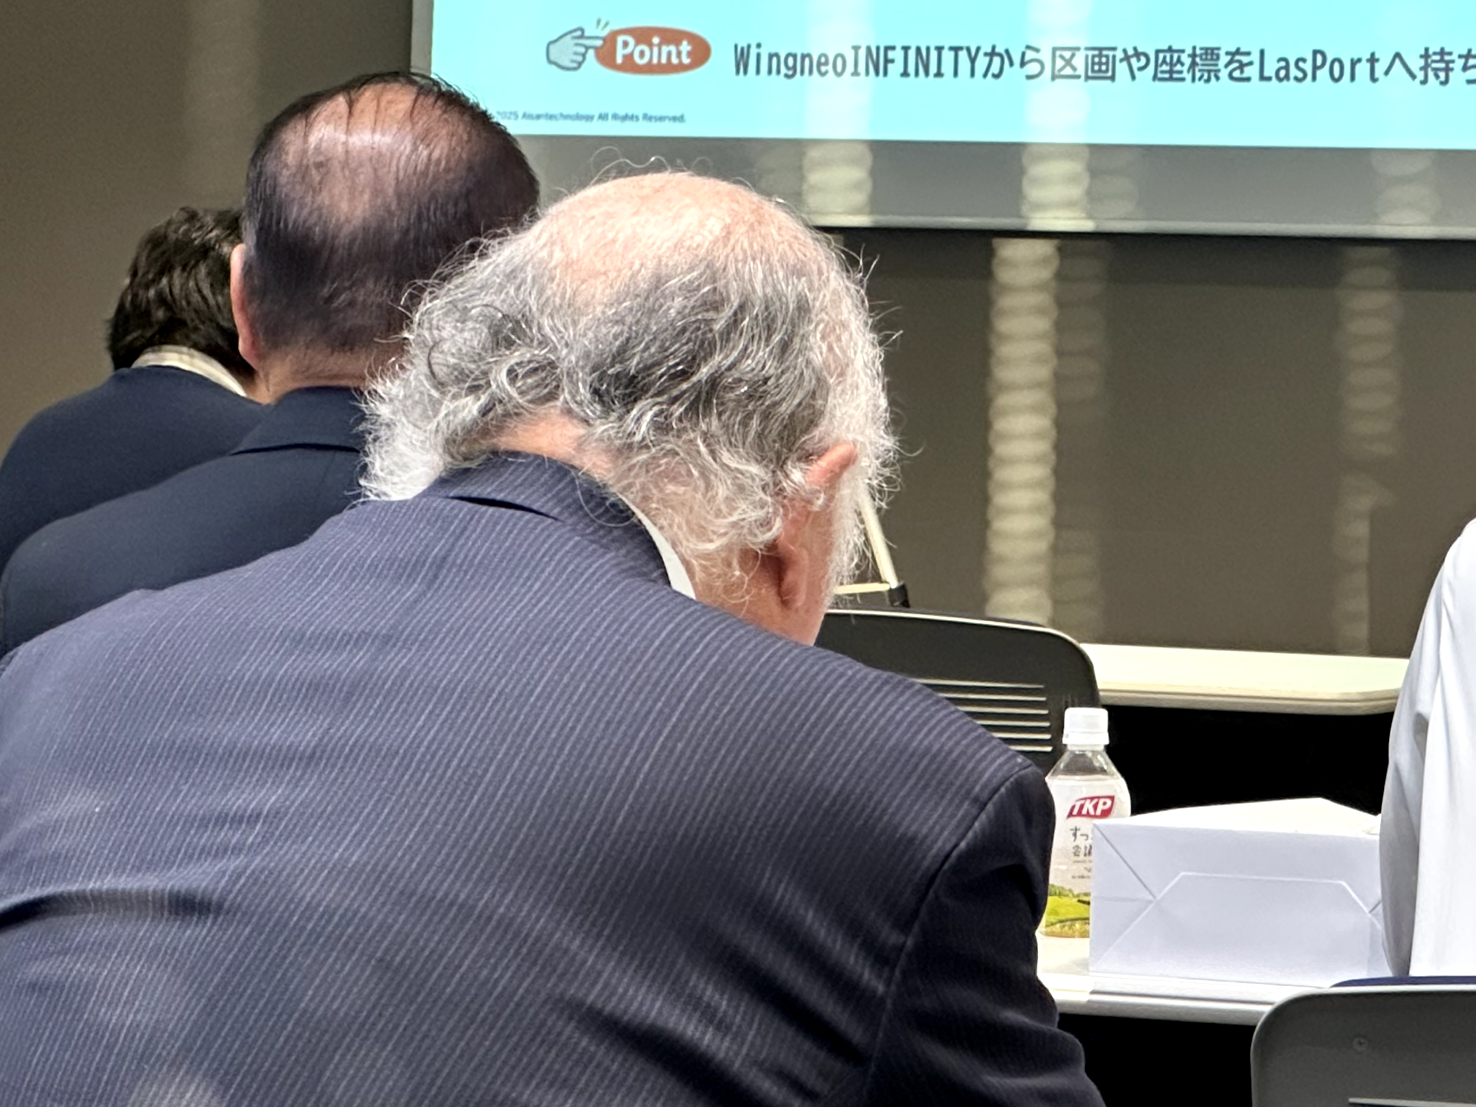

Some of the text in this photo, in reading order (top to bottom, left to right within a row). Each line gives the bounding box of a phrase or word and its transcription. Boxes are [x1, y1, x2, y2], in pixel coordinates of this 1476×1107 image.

[614, 33, 692, 66] Point
[611, 112, 640, 123] Rights
[1072, 798, 1112, 816] TKP
